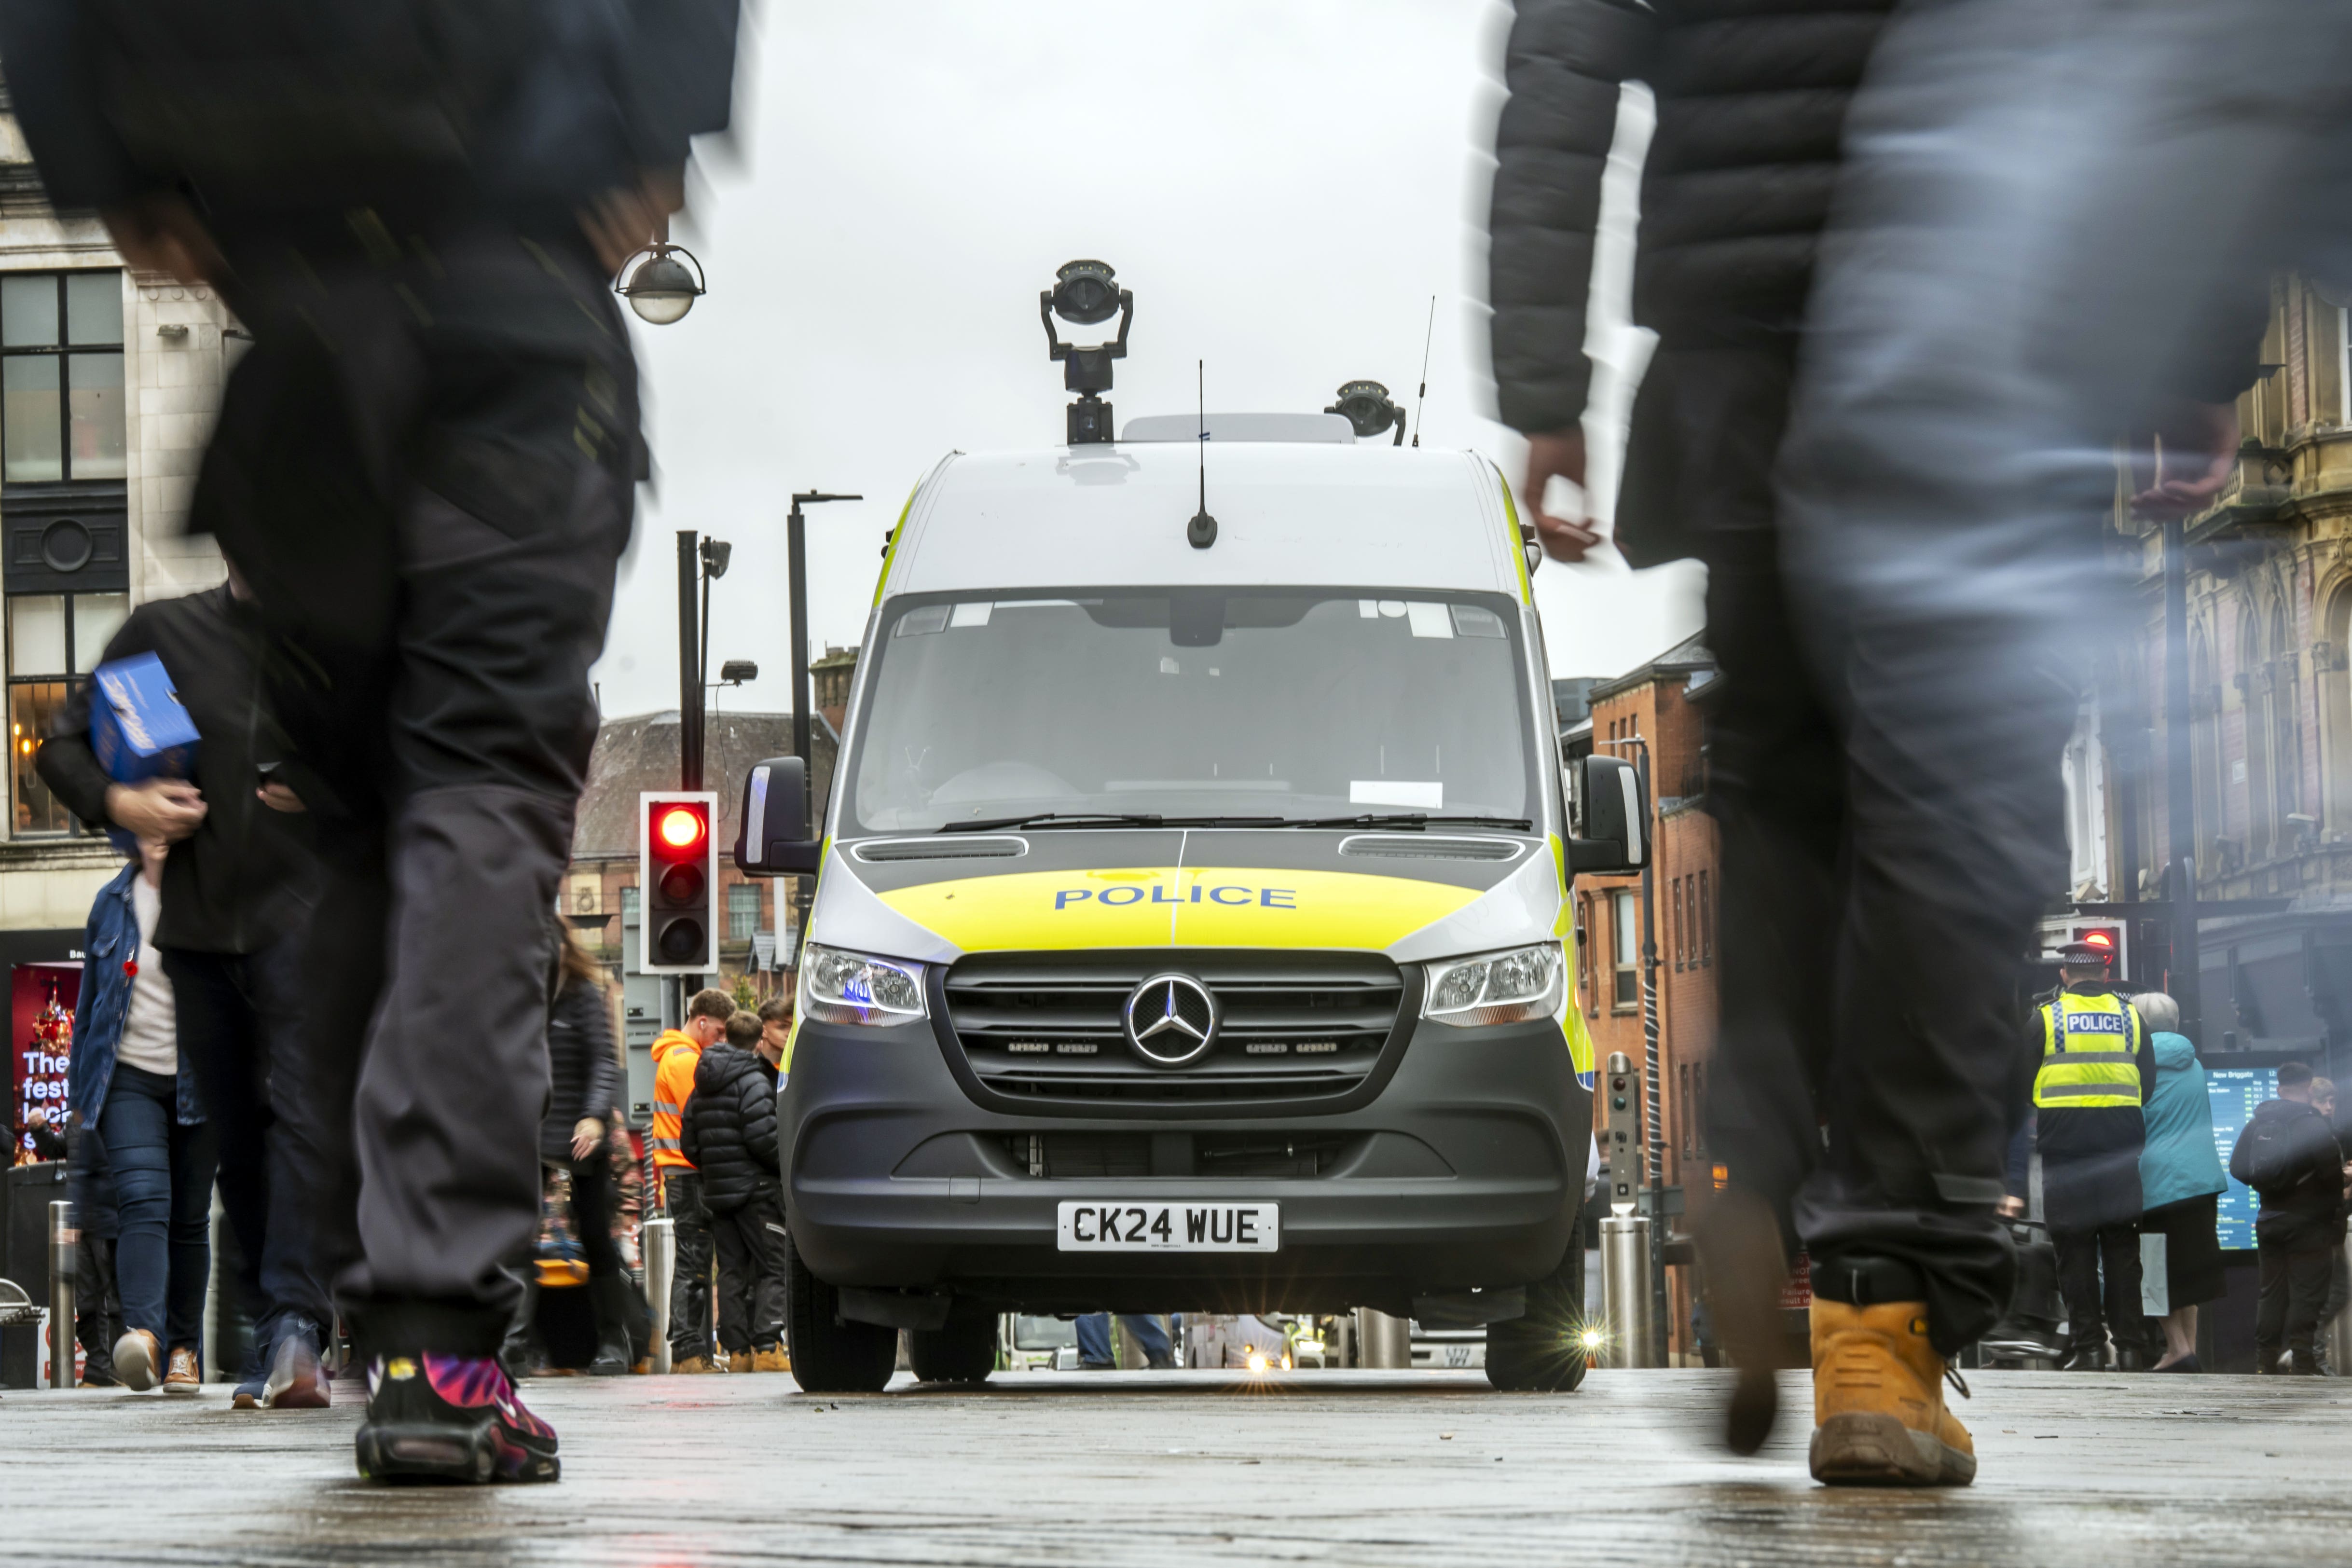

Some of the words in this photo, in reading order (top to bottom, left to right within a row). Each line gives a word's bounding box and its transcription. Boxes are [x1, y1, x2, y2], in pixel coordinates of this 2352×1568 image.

[1055, 885, 1296, 910] POLICE
[69, 949, 86, 959] Bau
[2069, 1015, 2122, 1031] POLICE
[23, 1051, 70, 1074] The
[23, 1077, 69, 1099] fest
[1074, 1208, 1172, 1243] CK24
[1186, 1209, 1258, 1244] WUE
